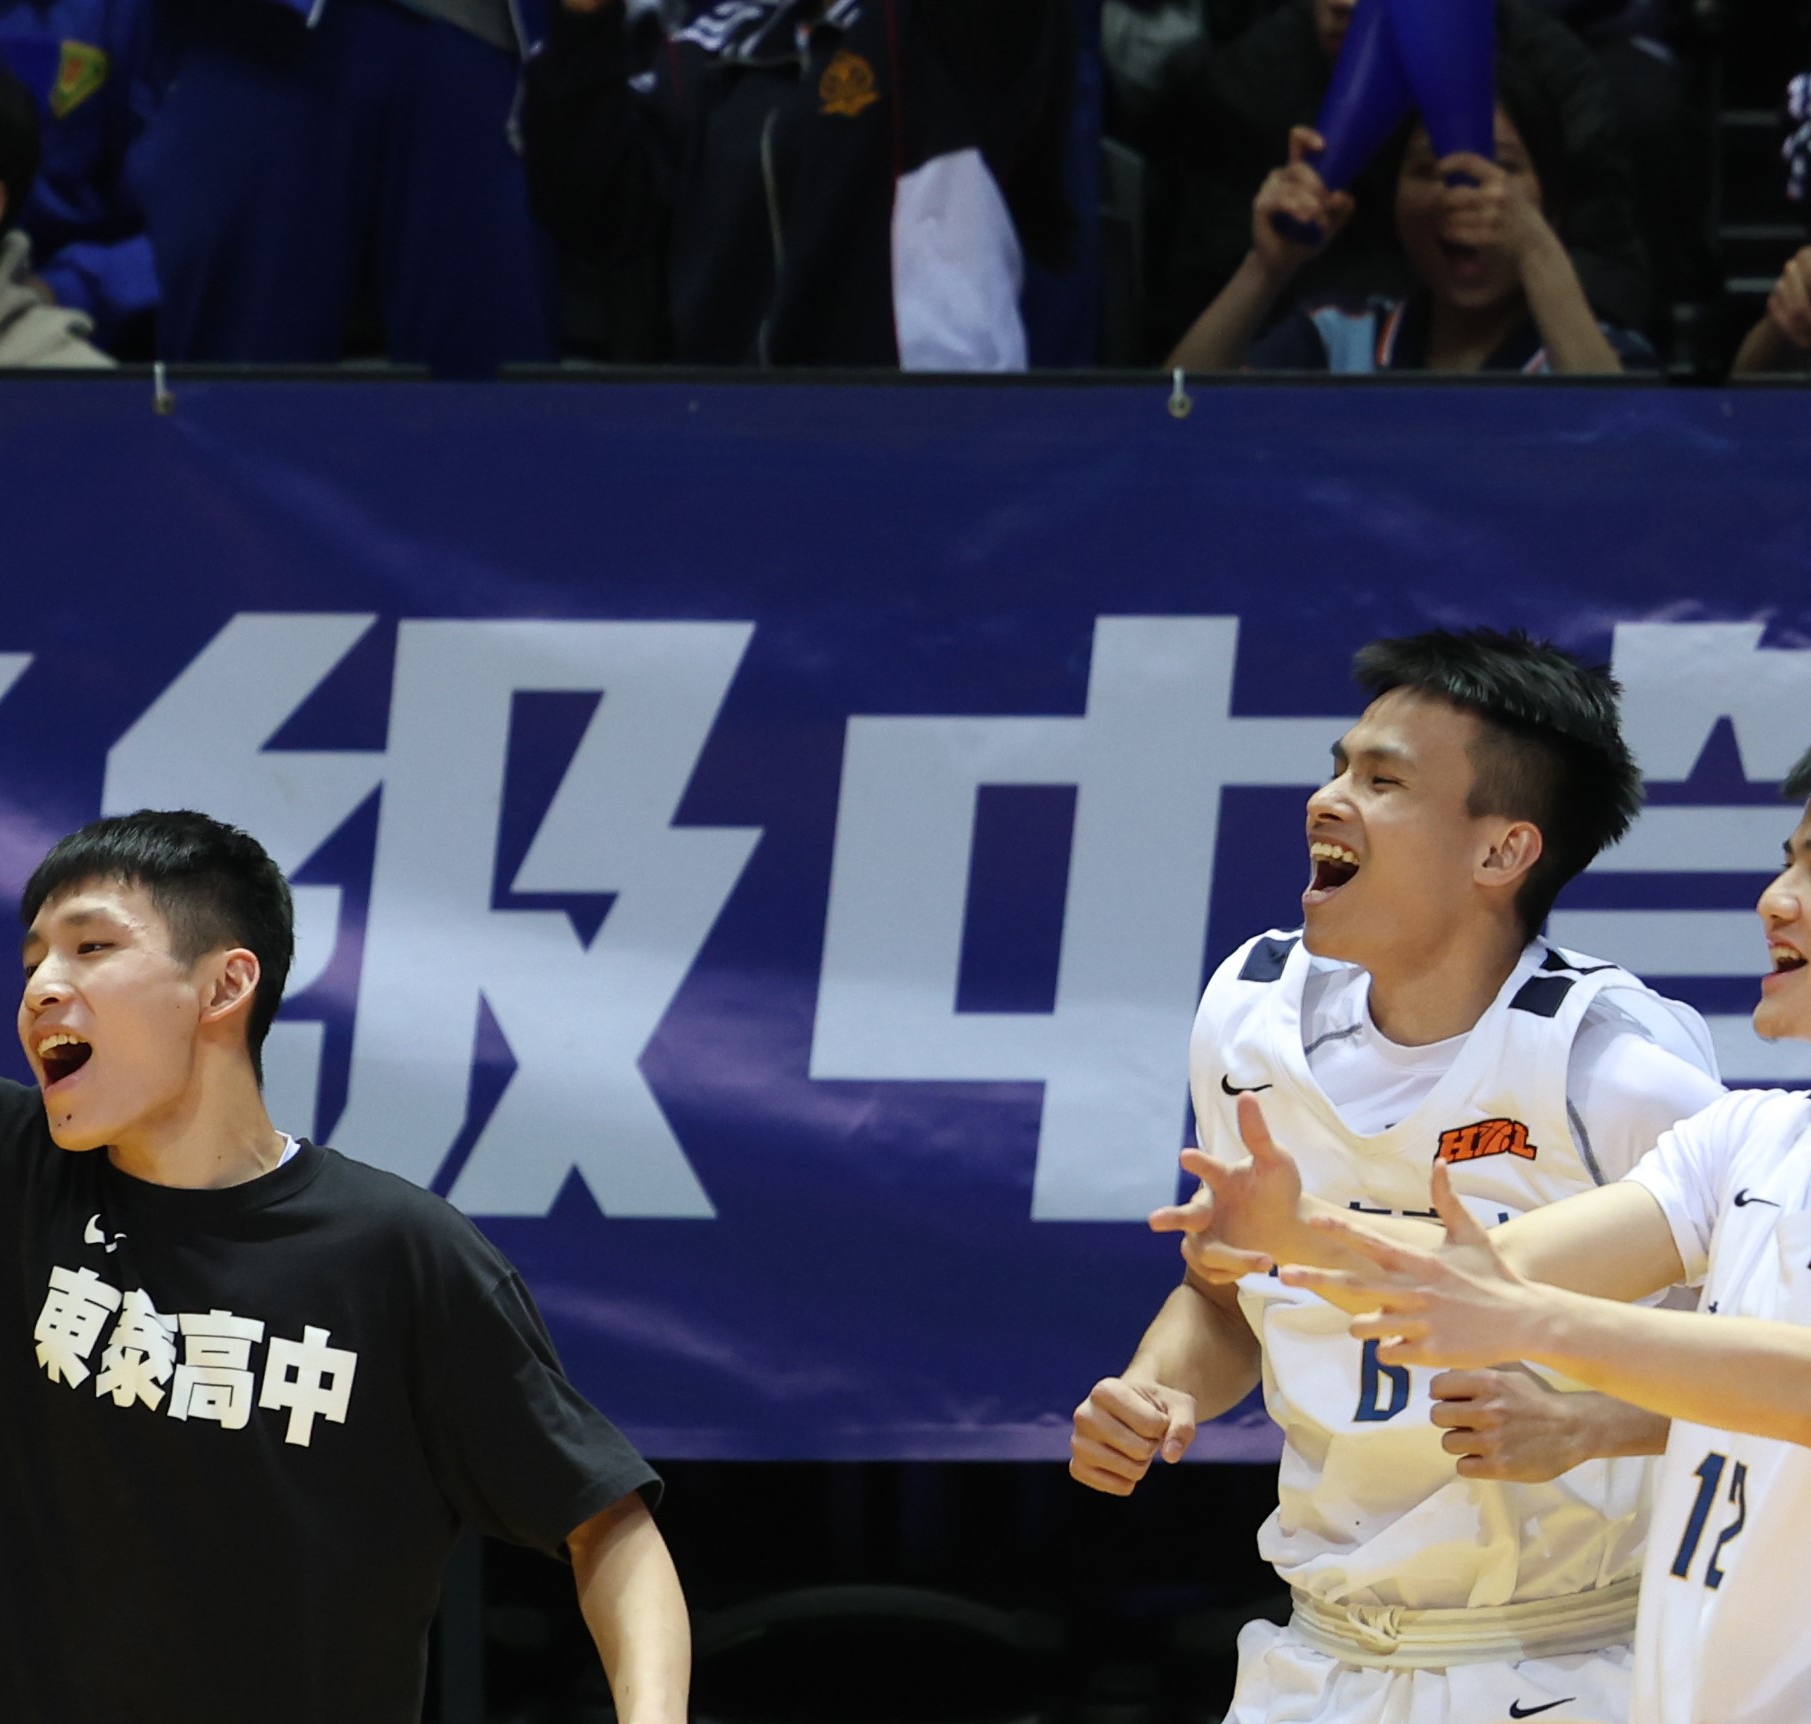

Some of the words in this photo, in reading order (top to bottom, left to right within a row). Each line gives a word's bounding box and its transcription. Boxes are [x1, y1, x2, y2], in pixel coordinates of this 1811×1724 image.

[32, 1265, 358, 1447] 東泰高中
[1670, 1450, 1748, 1591] 12
